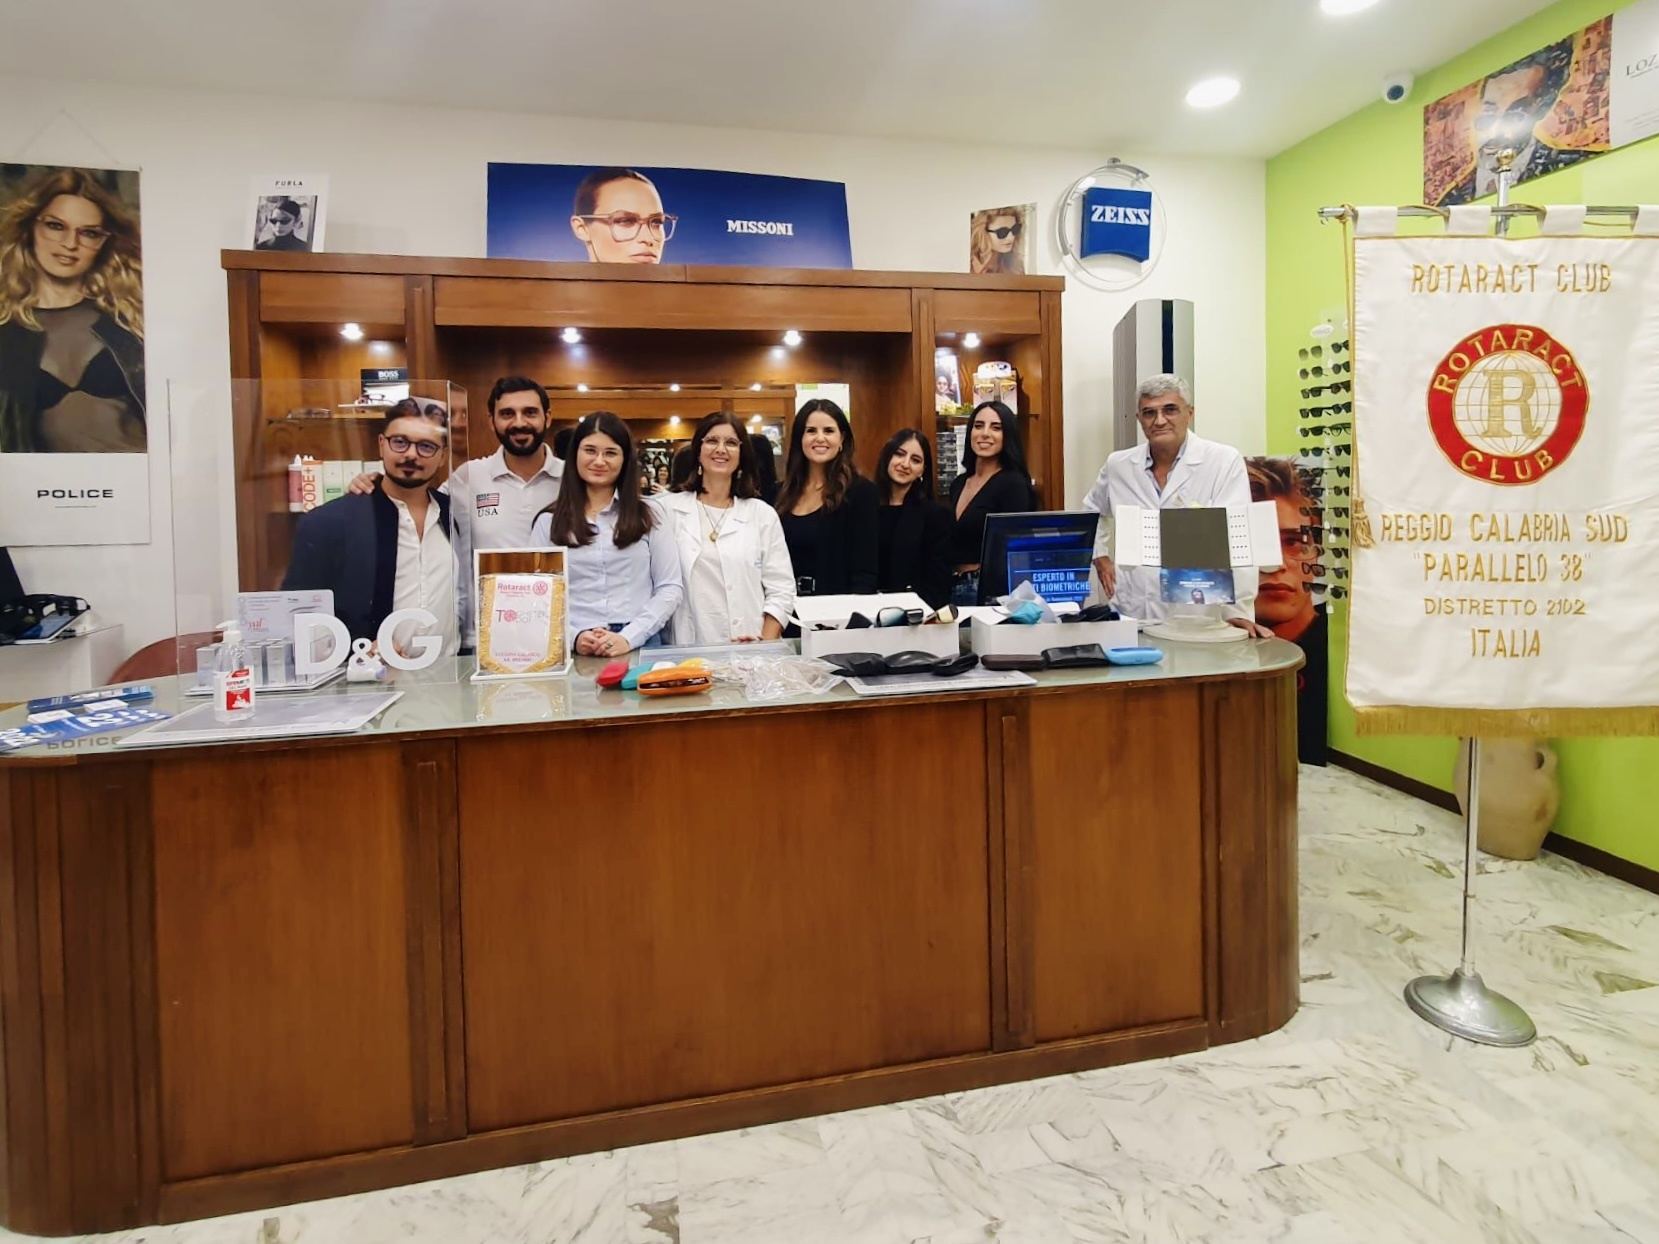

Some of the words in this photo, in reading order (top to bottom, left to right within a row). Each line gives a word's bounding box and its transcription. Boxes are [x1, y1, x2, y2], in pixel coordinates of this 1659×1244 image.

[1091, 205, 1150, 226] ZEISS
[726, 220, 795, 236] MISSONI
[1411, 263, 1539, 293] ROTARACT
[1557, 263, 1612, 293] CLUB
[1432, 328, 1582, 395] ROTARACT
[378, 370, 399, 378] BOSS
[1460, 449, 1555, 480] CLUB
[37, 489, 114, 499] POLICE
[303, 466, 316, 513] CODE+
[477, 507, 498, 517] USA
[1381, 512, 1452, 542] REGGIO
[1470, 513, 1571, 543] CALABRIA
[1586, 514, 1629, 543] SUD
[1032, 572, 1065, 582] ESPERTO
[1066, 571, 1075, 581] IN
[497, 583, 531, 591] Rotaract
[1040, 581, 1090, 593] BIOMETRICHE
[1424, 598, 1538, 616] DISTRETTO
[1546, 598, 1587, 616] 2102
[294, 608, 443, 676] D&G
[1471, 628, 1542, 658] ITALIA
